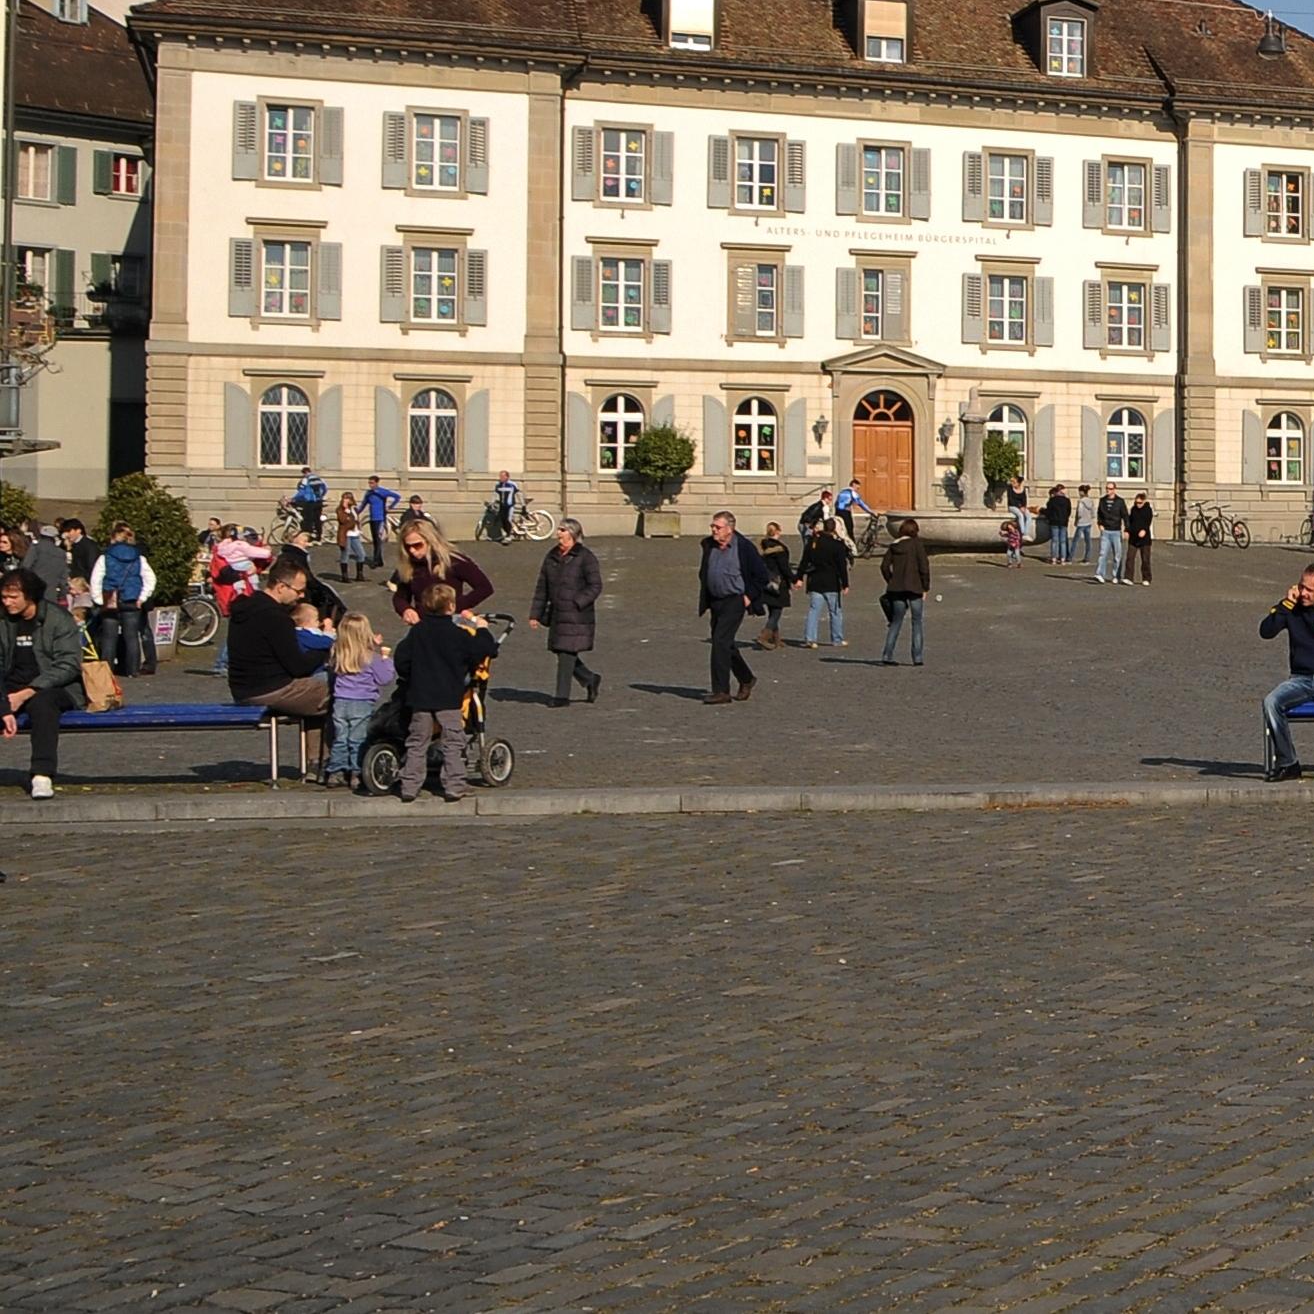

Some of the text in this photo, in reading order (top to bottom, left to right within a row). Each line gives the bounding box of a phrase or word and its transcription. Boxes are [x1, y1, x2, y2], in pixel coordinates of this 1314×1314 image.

[815, 230, 840, 238] UND
[845, 231, 913, 241] PFLEGEHEIM
[918, 233, 997, 245] BÜRGERSPITAL
